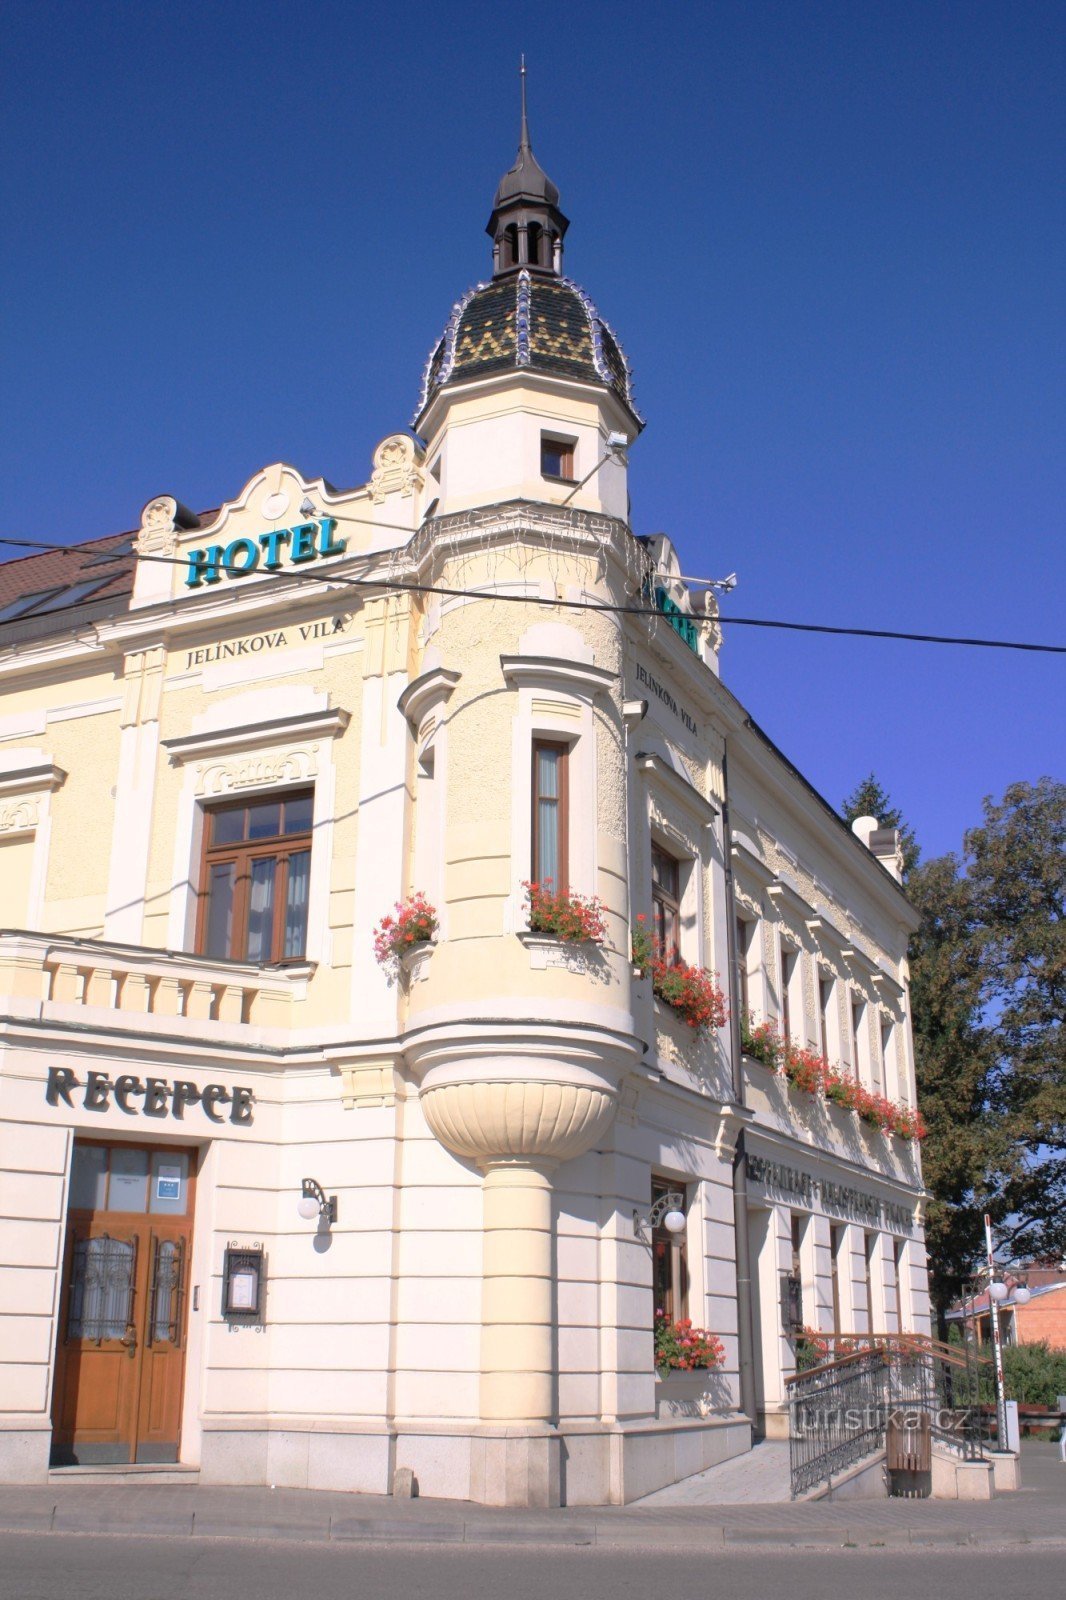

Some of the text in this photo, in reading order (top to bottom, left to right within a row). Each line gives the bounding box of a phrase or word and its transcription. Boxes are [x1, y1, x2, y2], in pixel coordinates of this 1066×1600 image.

[184, 518, 347, 588] HOTEL
[299, 619, 345, 641] VILA
[680, 708, 698, 737] VILA
[46, 1066, 254, 1125] RECEPCE
